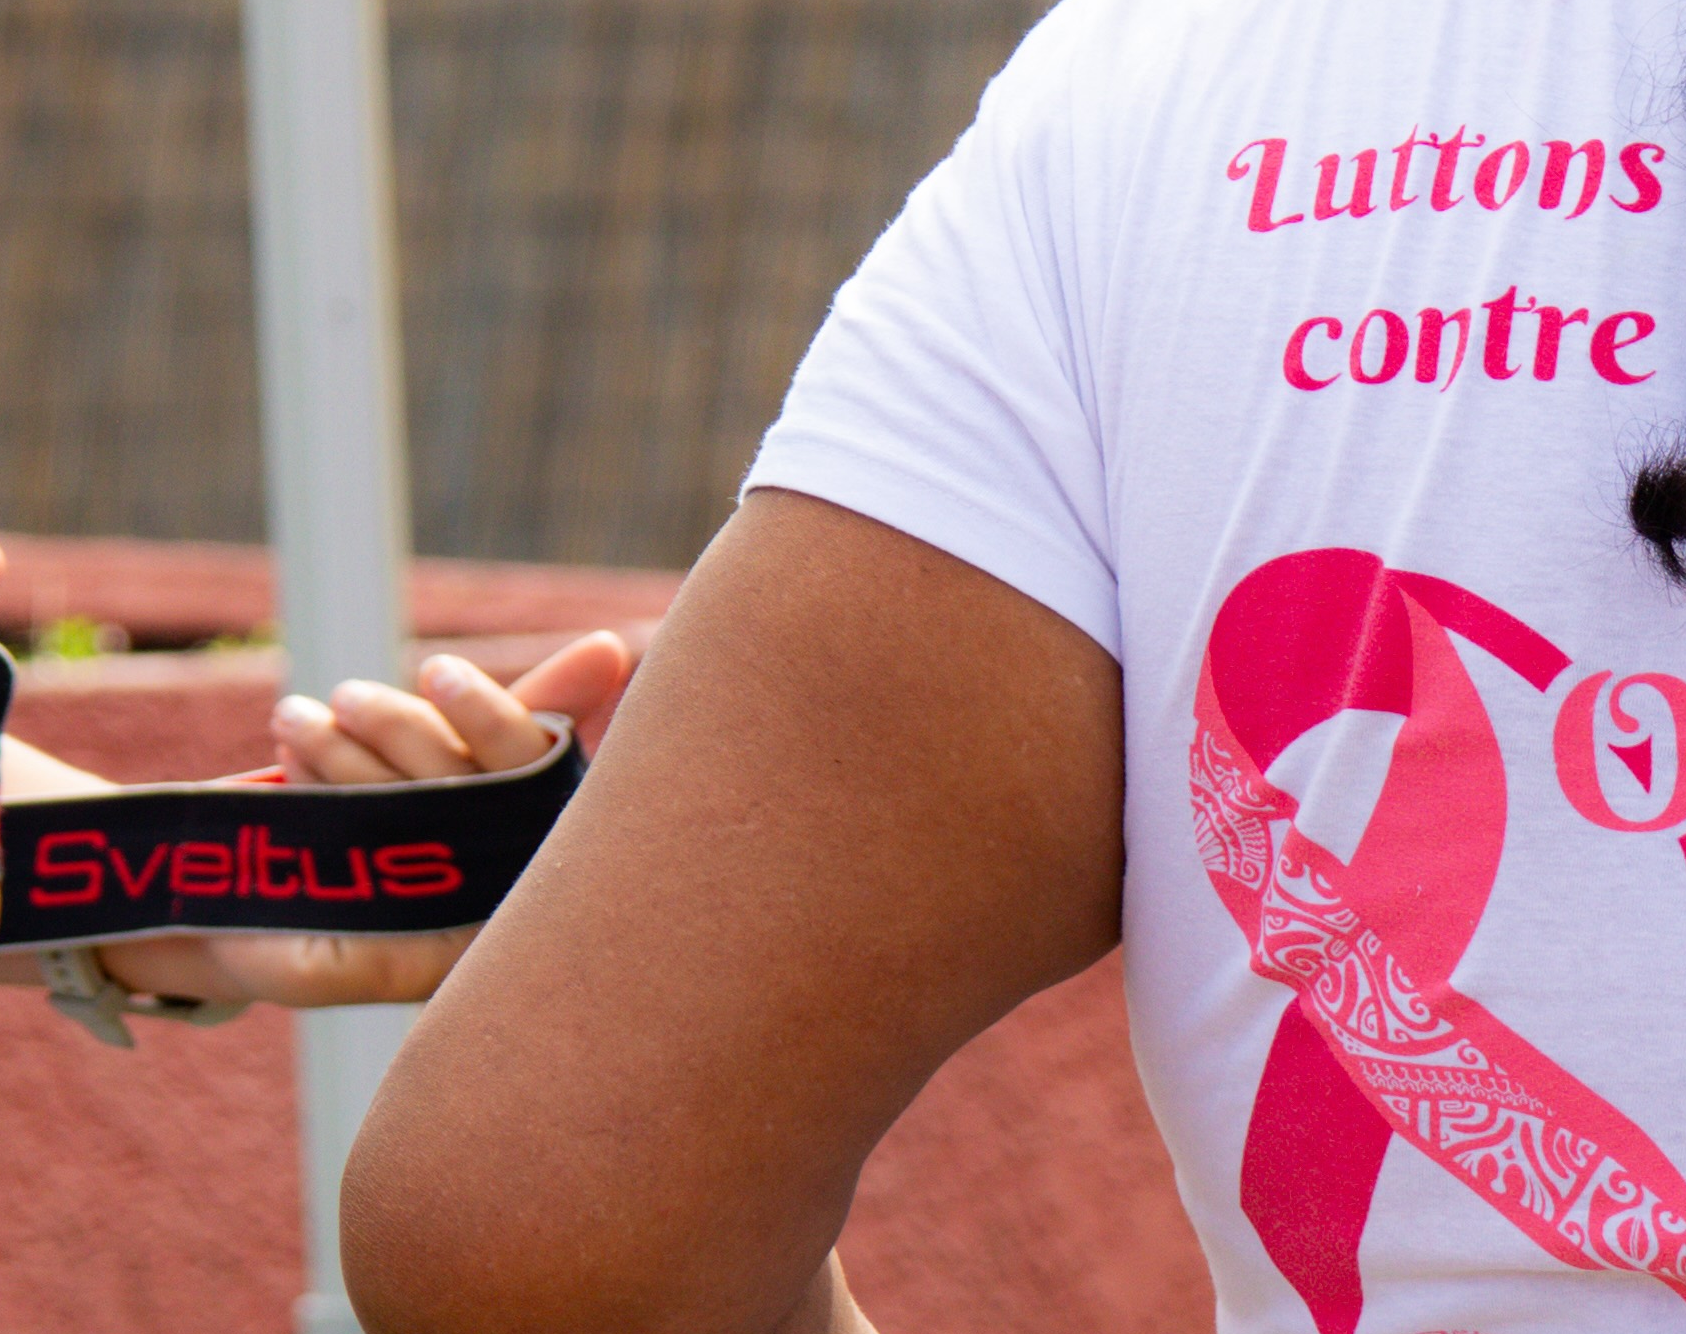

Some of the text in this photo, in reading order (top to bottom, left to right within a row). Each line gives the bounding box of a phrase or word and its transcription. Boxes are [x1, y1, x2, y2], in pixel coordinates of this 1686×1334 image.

[1226, 123, 1666, 234] Luttons
[1282, 284, 1657, 393] contre
[28, 824, 464, 908] Sveltus
